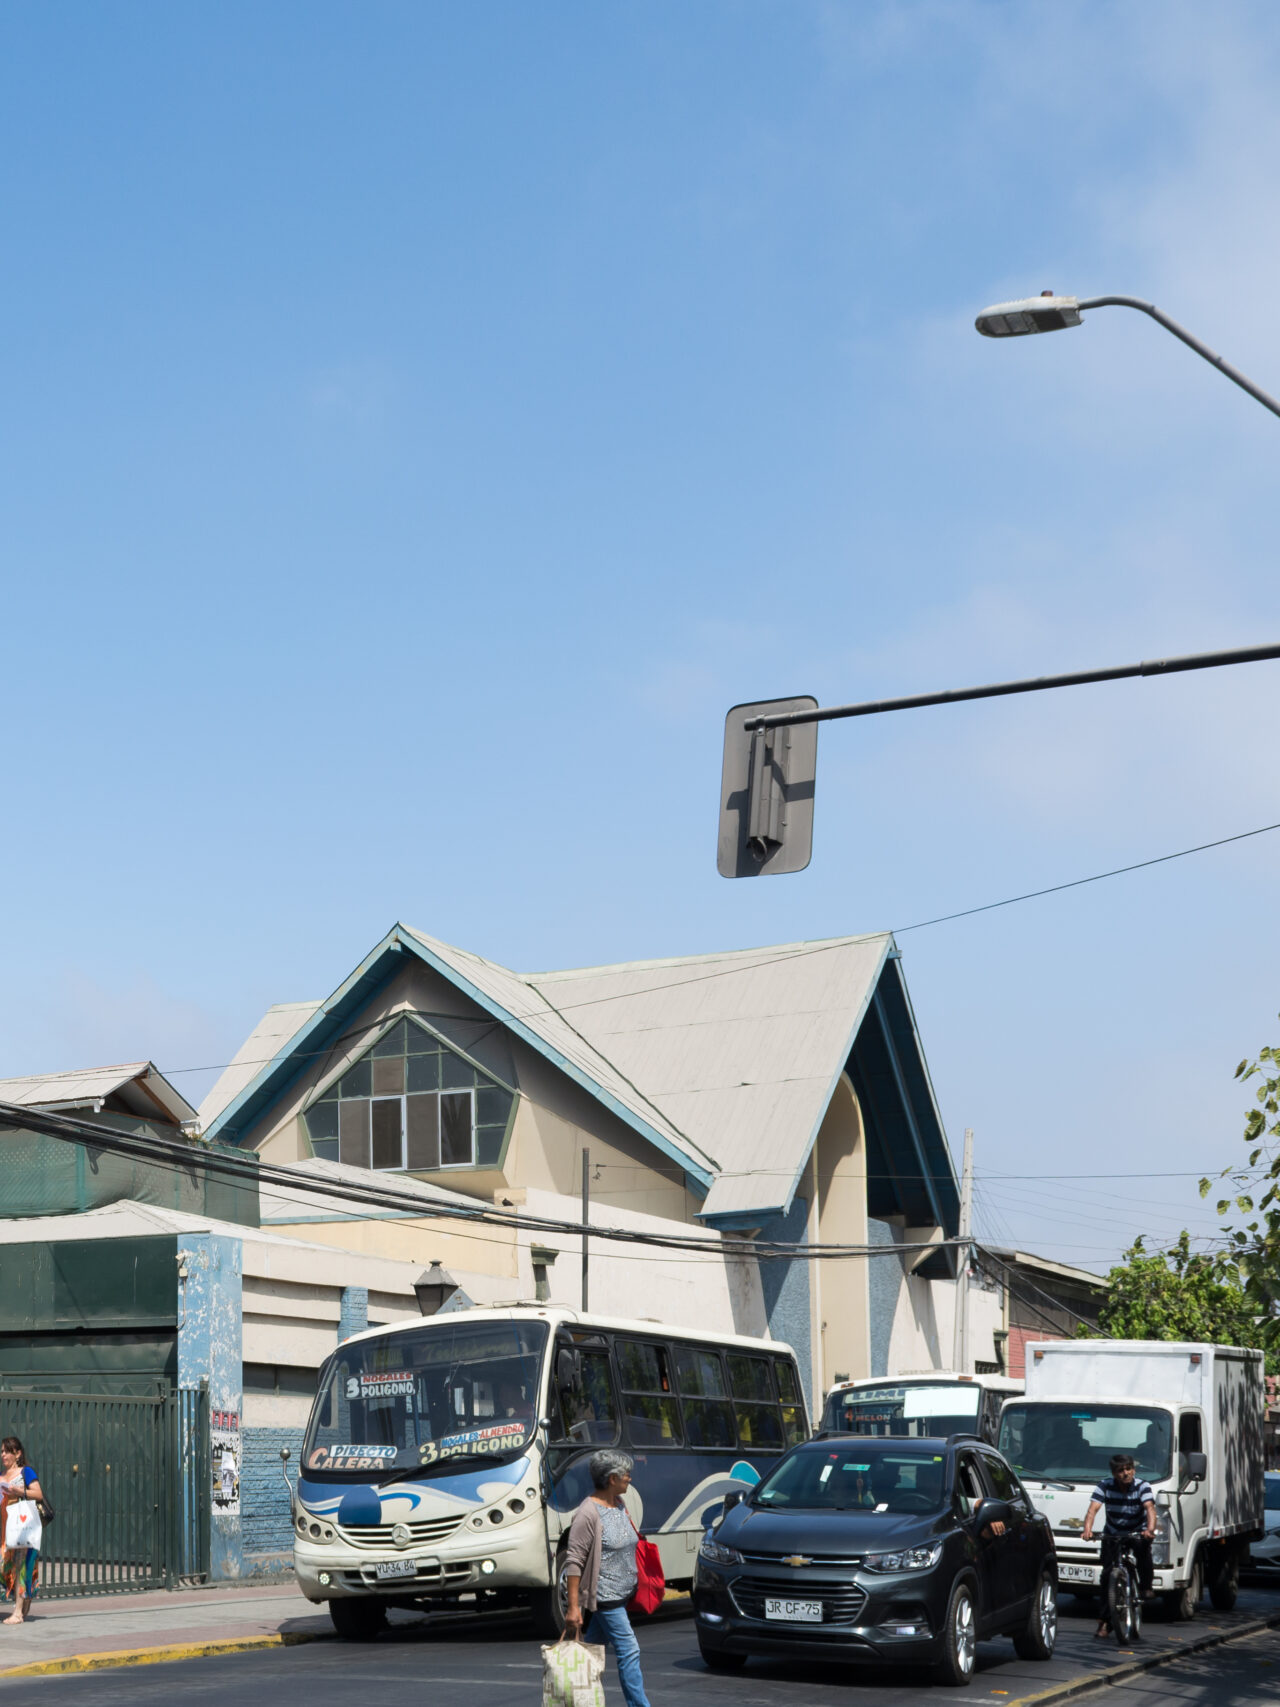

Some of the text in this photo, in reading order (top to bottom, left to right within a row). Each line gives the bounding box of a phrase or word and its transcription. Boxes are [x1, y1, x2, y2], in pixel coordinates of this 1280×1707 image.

[346, 1377, 360, 1398] 3
[362, 1372, 412, 1384] NOGALES
[308, 1447, 385, 1470] CALERA
[335, 1445, 396, 1458] DIRECTO
[419, 1441, 439, 1465] 3
